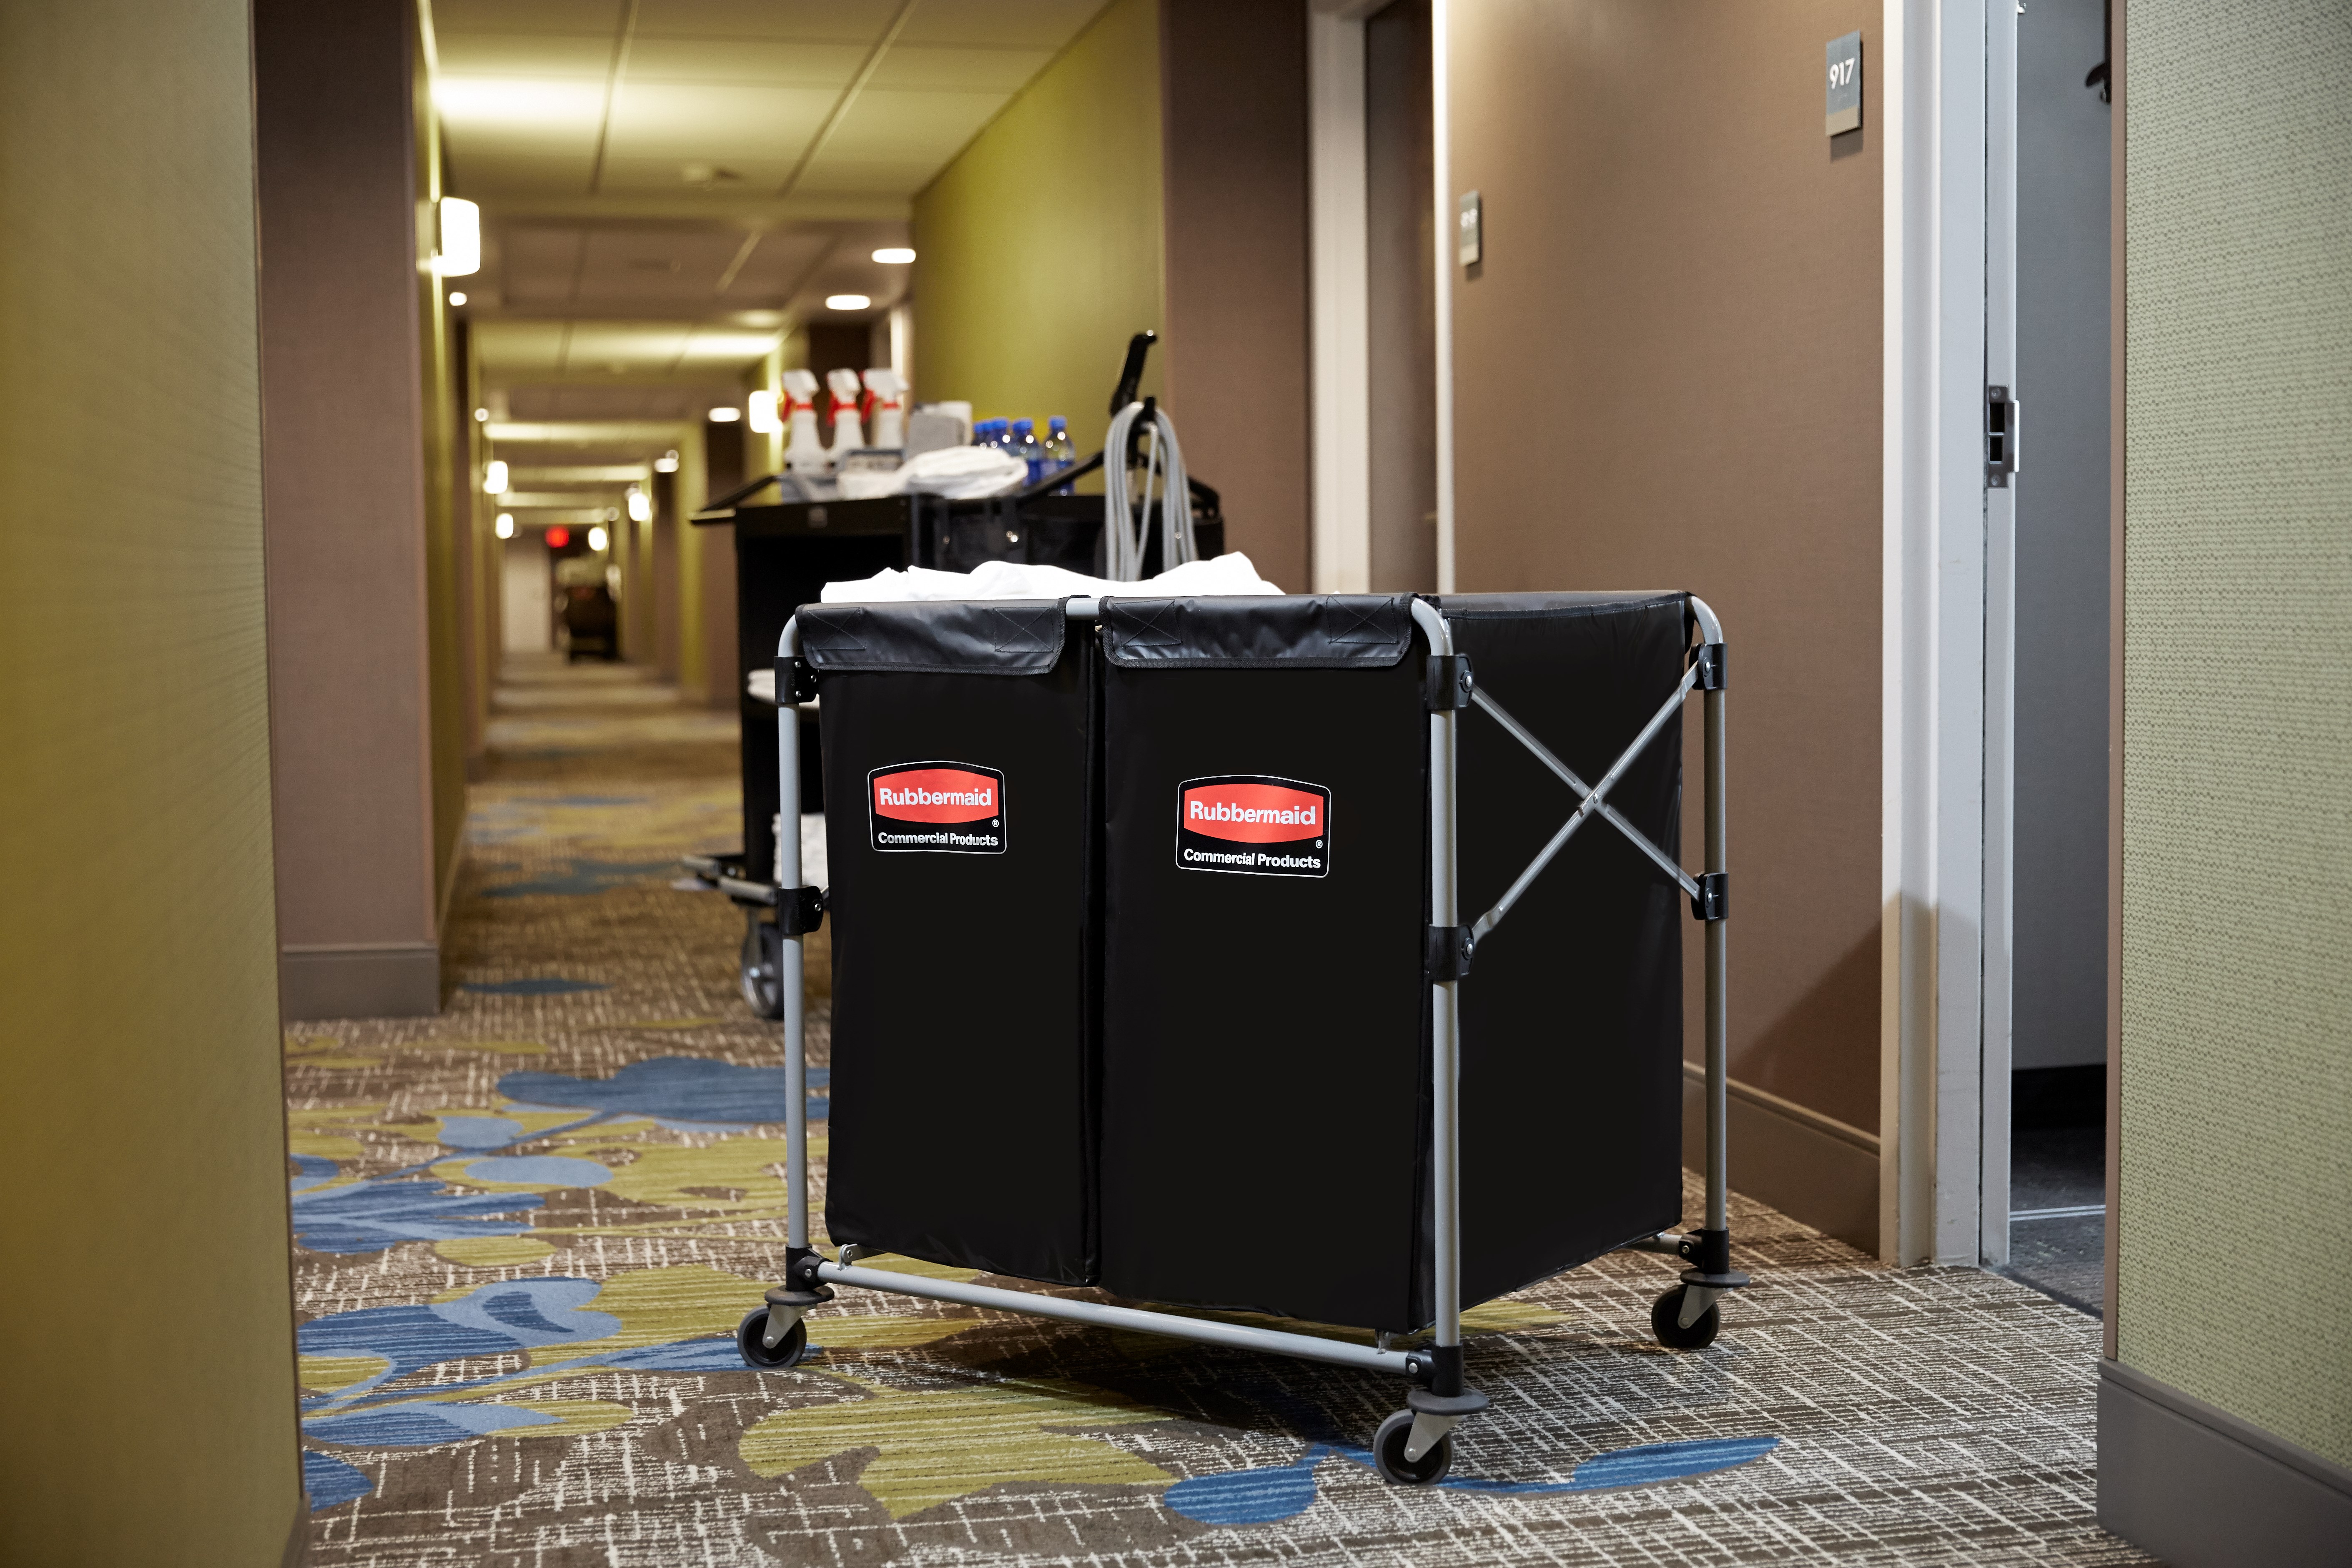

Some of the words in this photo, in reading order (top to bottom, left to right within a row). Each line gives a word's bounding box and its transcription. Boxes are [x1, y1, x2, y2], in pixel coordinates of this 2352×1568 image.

[1829, 57, 1855, 90] 917
[879, 787, 992, 806] Rubbermaid
[1190, 800, 1316, 825] Rubbermaid
[878, 832, 948, 844] Commercial
[950, 833, 998, 846] Products
[1184, 848, 1255, 866] Commercial
[1257, 853, 1321, 869] Products
